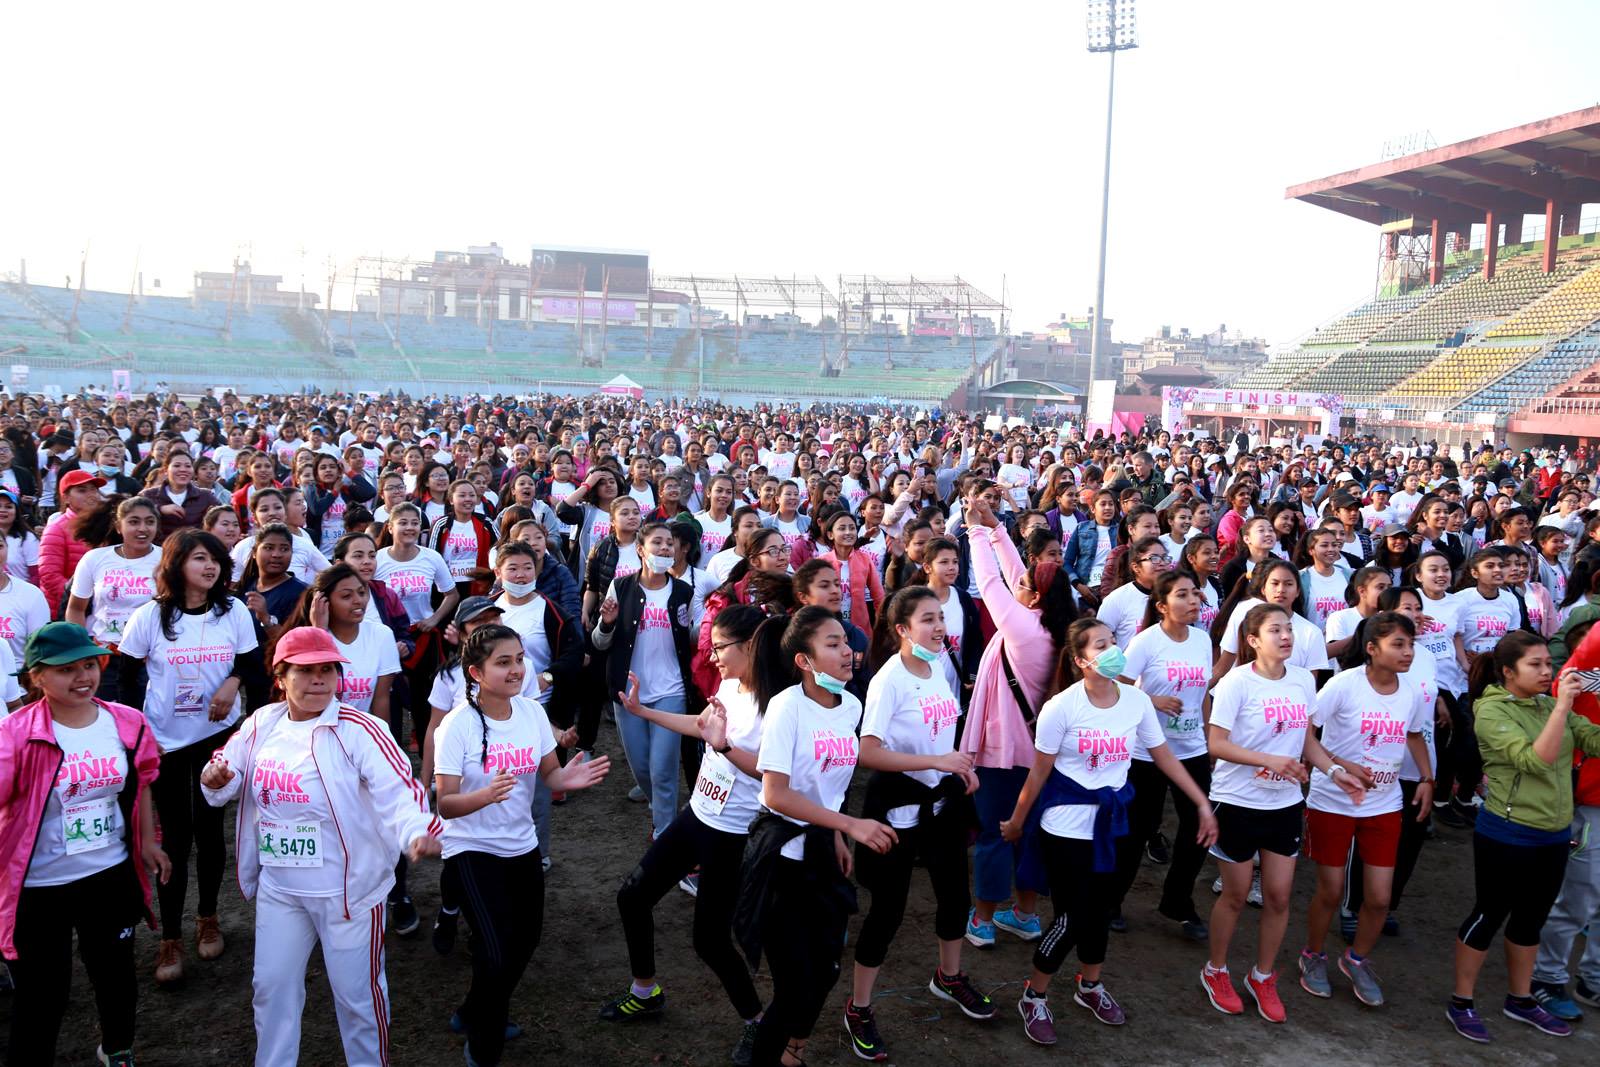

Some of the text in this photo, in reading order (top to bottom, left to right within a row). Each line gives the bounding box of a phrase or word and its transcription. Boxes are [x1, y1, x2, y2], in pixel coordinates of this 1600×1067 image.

[1225, 391, 1298, 405] FINISH
[447, 537, 477, 547] PINK
[103, 575, 149, 588] PINK
[390, 575, 427, 588] PINK
[1476, 620, 1508, 632] PINK
[1167, 665, 1205, 681] PINK
[1268, 696, 1282, 705] AM
[922, 698, 958, 725] PINK
[1264, 703, 1308, 724] PINK
[1367, 711, 1382, 719] AM
[1384, 711, 1391, 719] A
[1085, 729, 1101, 737] AM
[1103, 729, 1110, 737] A
[1360, 719, 1406, 736] PINK
[489, 743, 505, 753] AM
[507, 742, 515, 750] A
[814, 736, 855, 760] PINK
[1078, 736, 1129, 755] PINK
[83, 750, 92, 760] A
[483, 746, 535, 775] PINK
[1104, 753, 1130, 762] SISTER
[53, 756, 120, 788] PINK
[259, 760, 276, 769] AM
[277, 761, 286, 771] A
[511, 765, 538, 776] SISTER
[87, 776, 123, 790] SISTER
[253, 767, 304, 794] PINK
[276, 792, 310, 804] SISTER
[296, 825, 317, 833] 5Km
[280, 837, 316, 856] 5479
